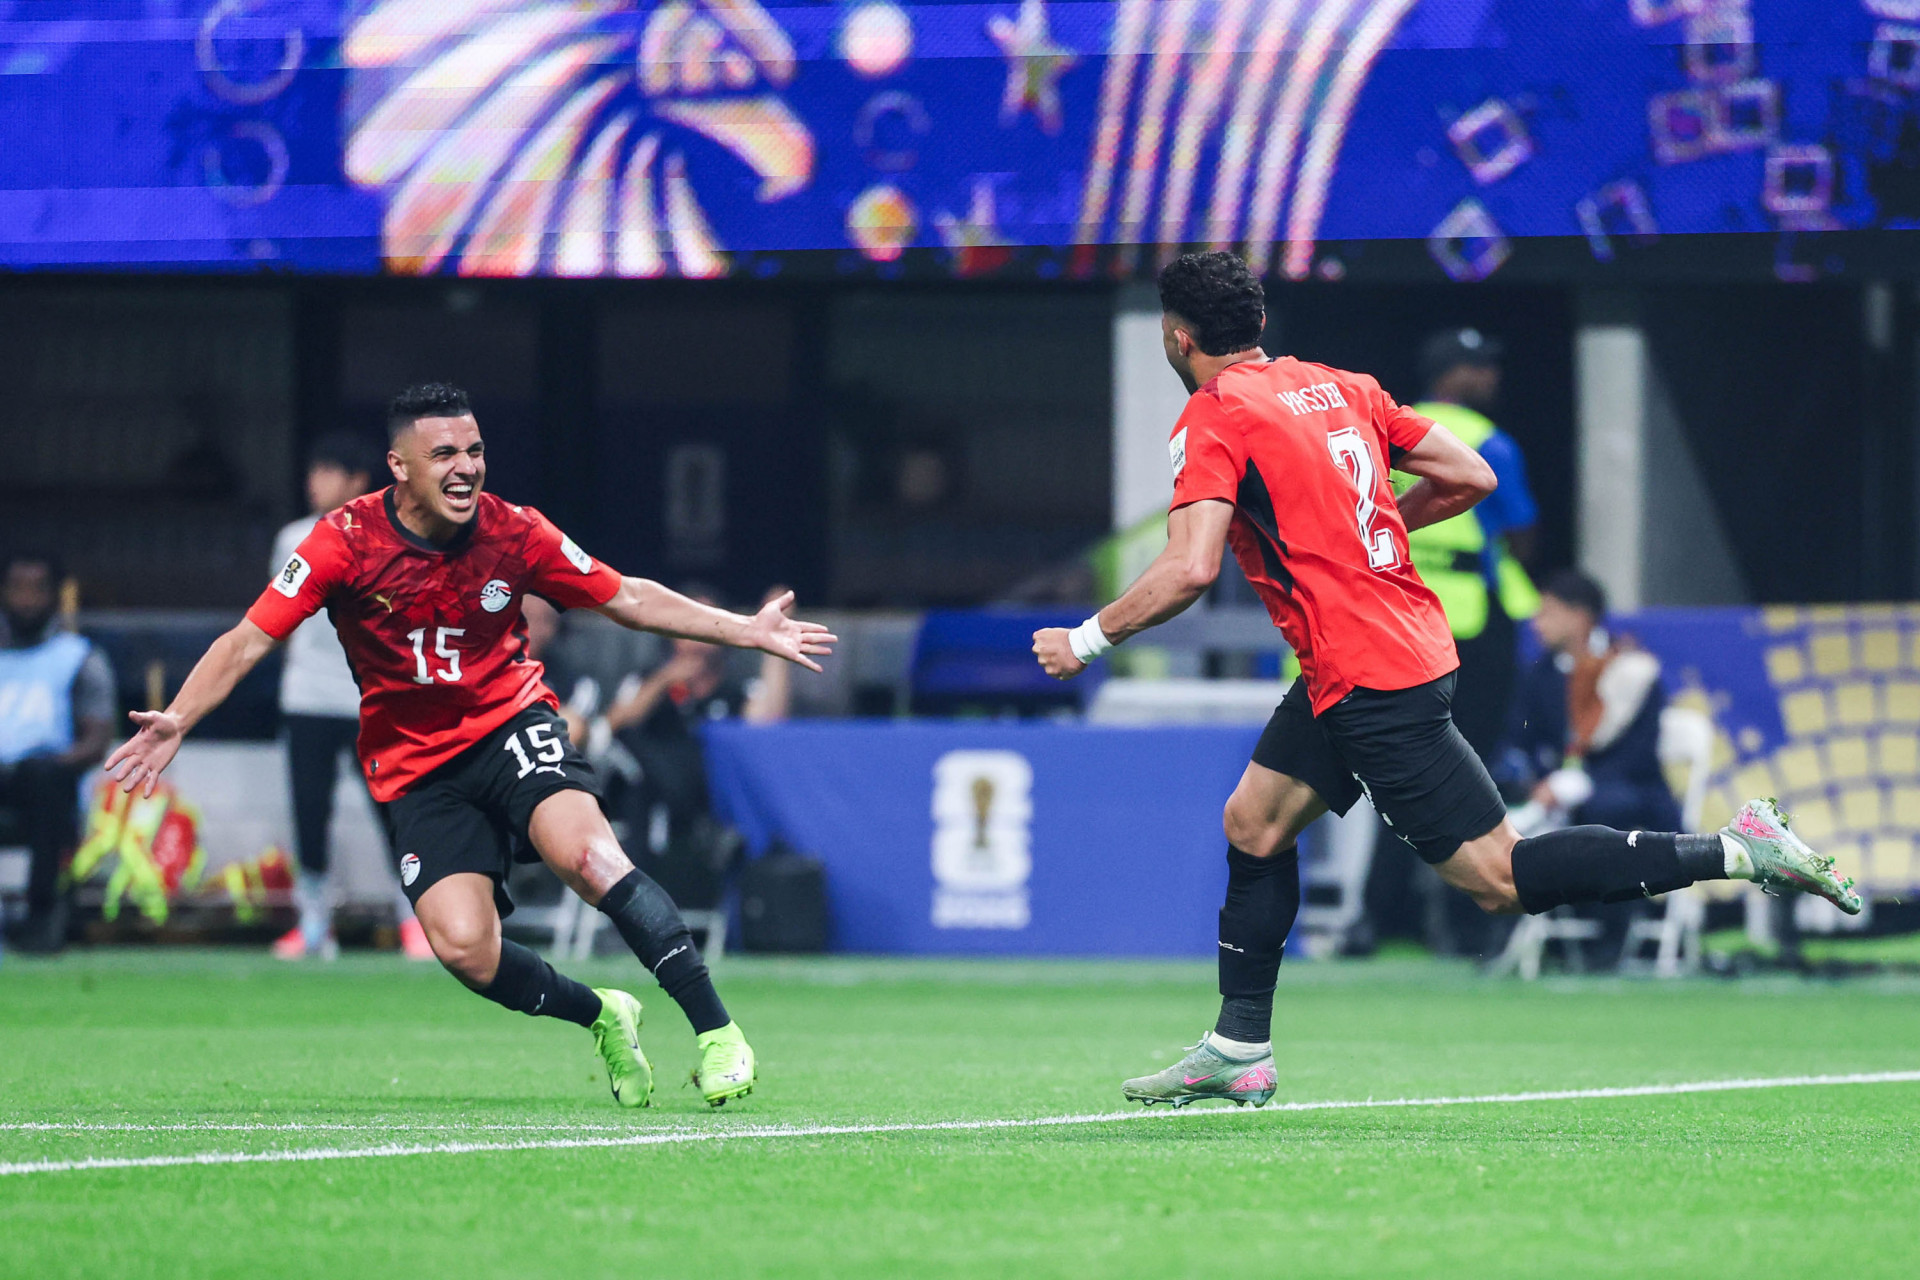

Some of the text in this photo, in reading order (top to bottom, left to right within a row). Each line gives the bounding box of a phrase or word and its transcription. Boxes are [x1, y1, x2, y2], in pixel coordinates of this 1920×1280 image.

[1276, 382, 1348, 415] YASSER
[1327, 426, 1401, 573] 2
[406, 627, 466, 684] 15
[504, 723, 565, 779] 15
